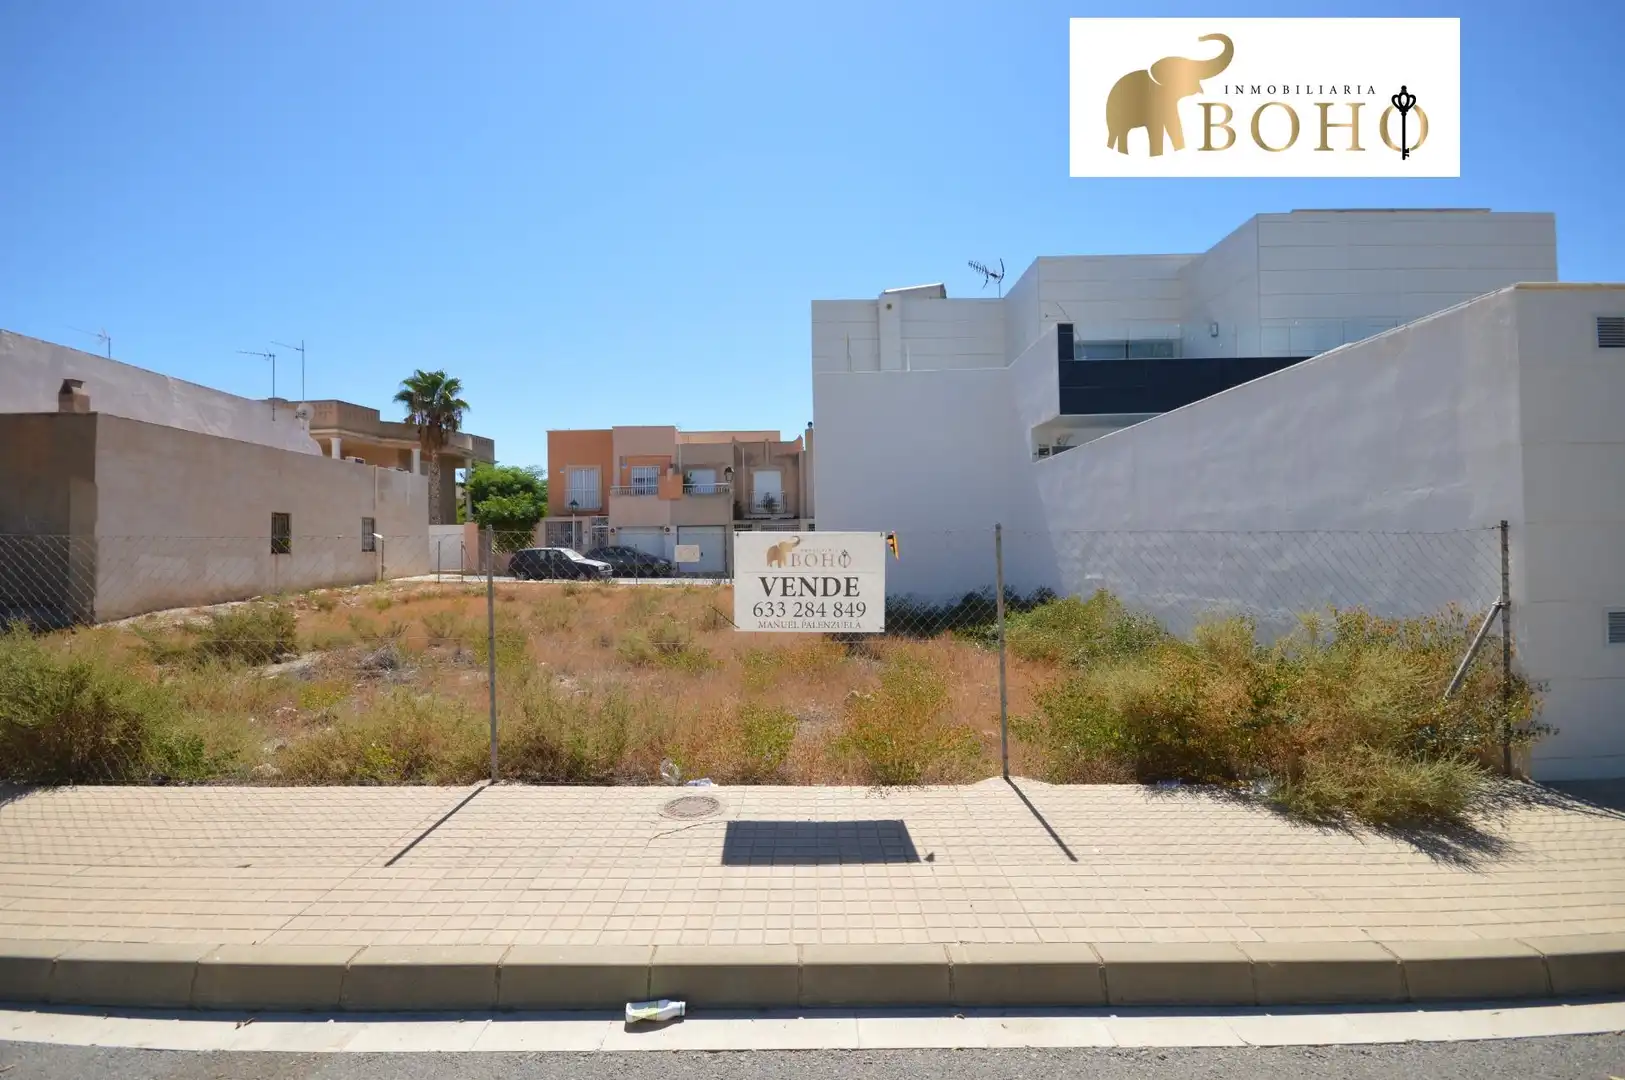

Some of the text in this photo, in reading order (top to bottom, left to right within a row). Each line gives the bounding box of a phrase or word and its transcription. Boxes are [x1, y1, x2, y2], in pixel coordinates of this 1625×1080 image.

[791, 552, 852, 568] BOHO
[758, 576, 860, 597] VENDE
[752, 601, 867, 618] 633 284 849
[758, 620, 862, 629] MANUEL PALENZUELA
